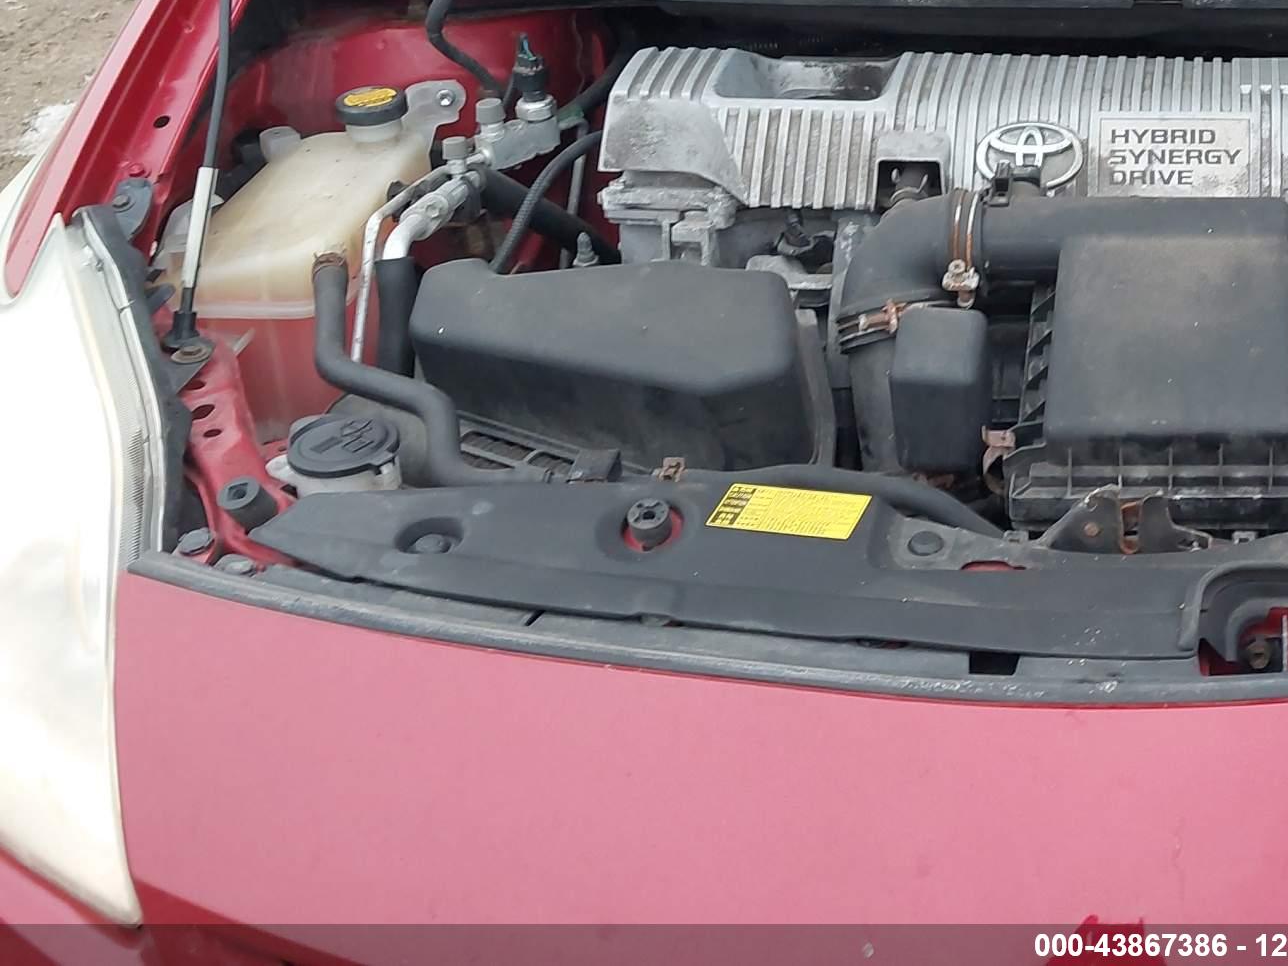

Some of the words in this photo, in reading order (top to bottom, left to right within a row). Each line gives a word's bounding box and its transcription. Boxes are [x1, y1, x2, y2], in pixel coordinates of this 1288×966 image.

[1111, 129, 1216, 144] HYBRID
[1109, 149, 1241, 165] SYNERGY
[1110, 170, 1193, 185] DRIVE
